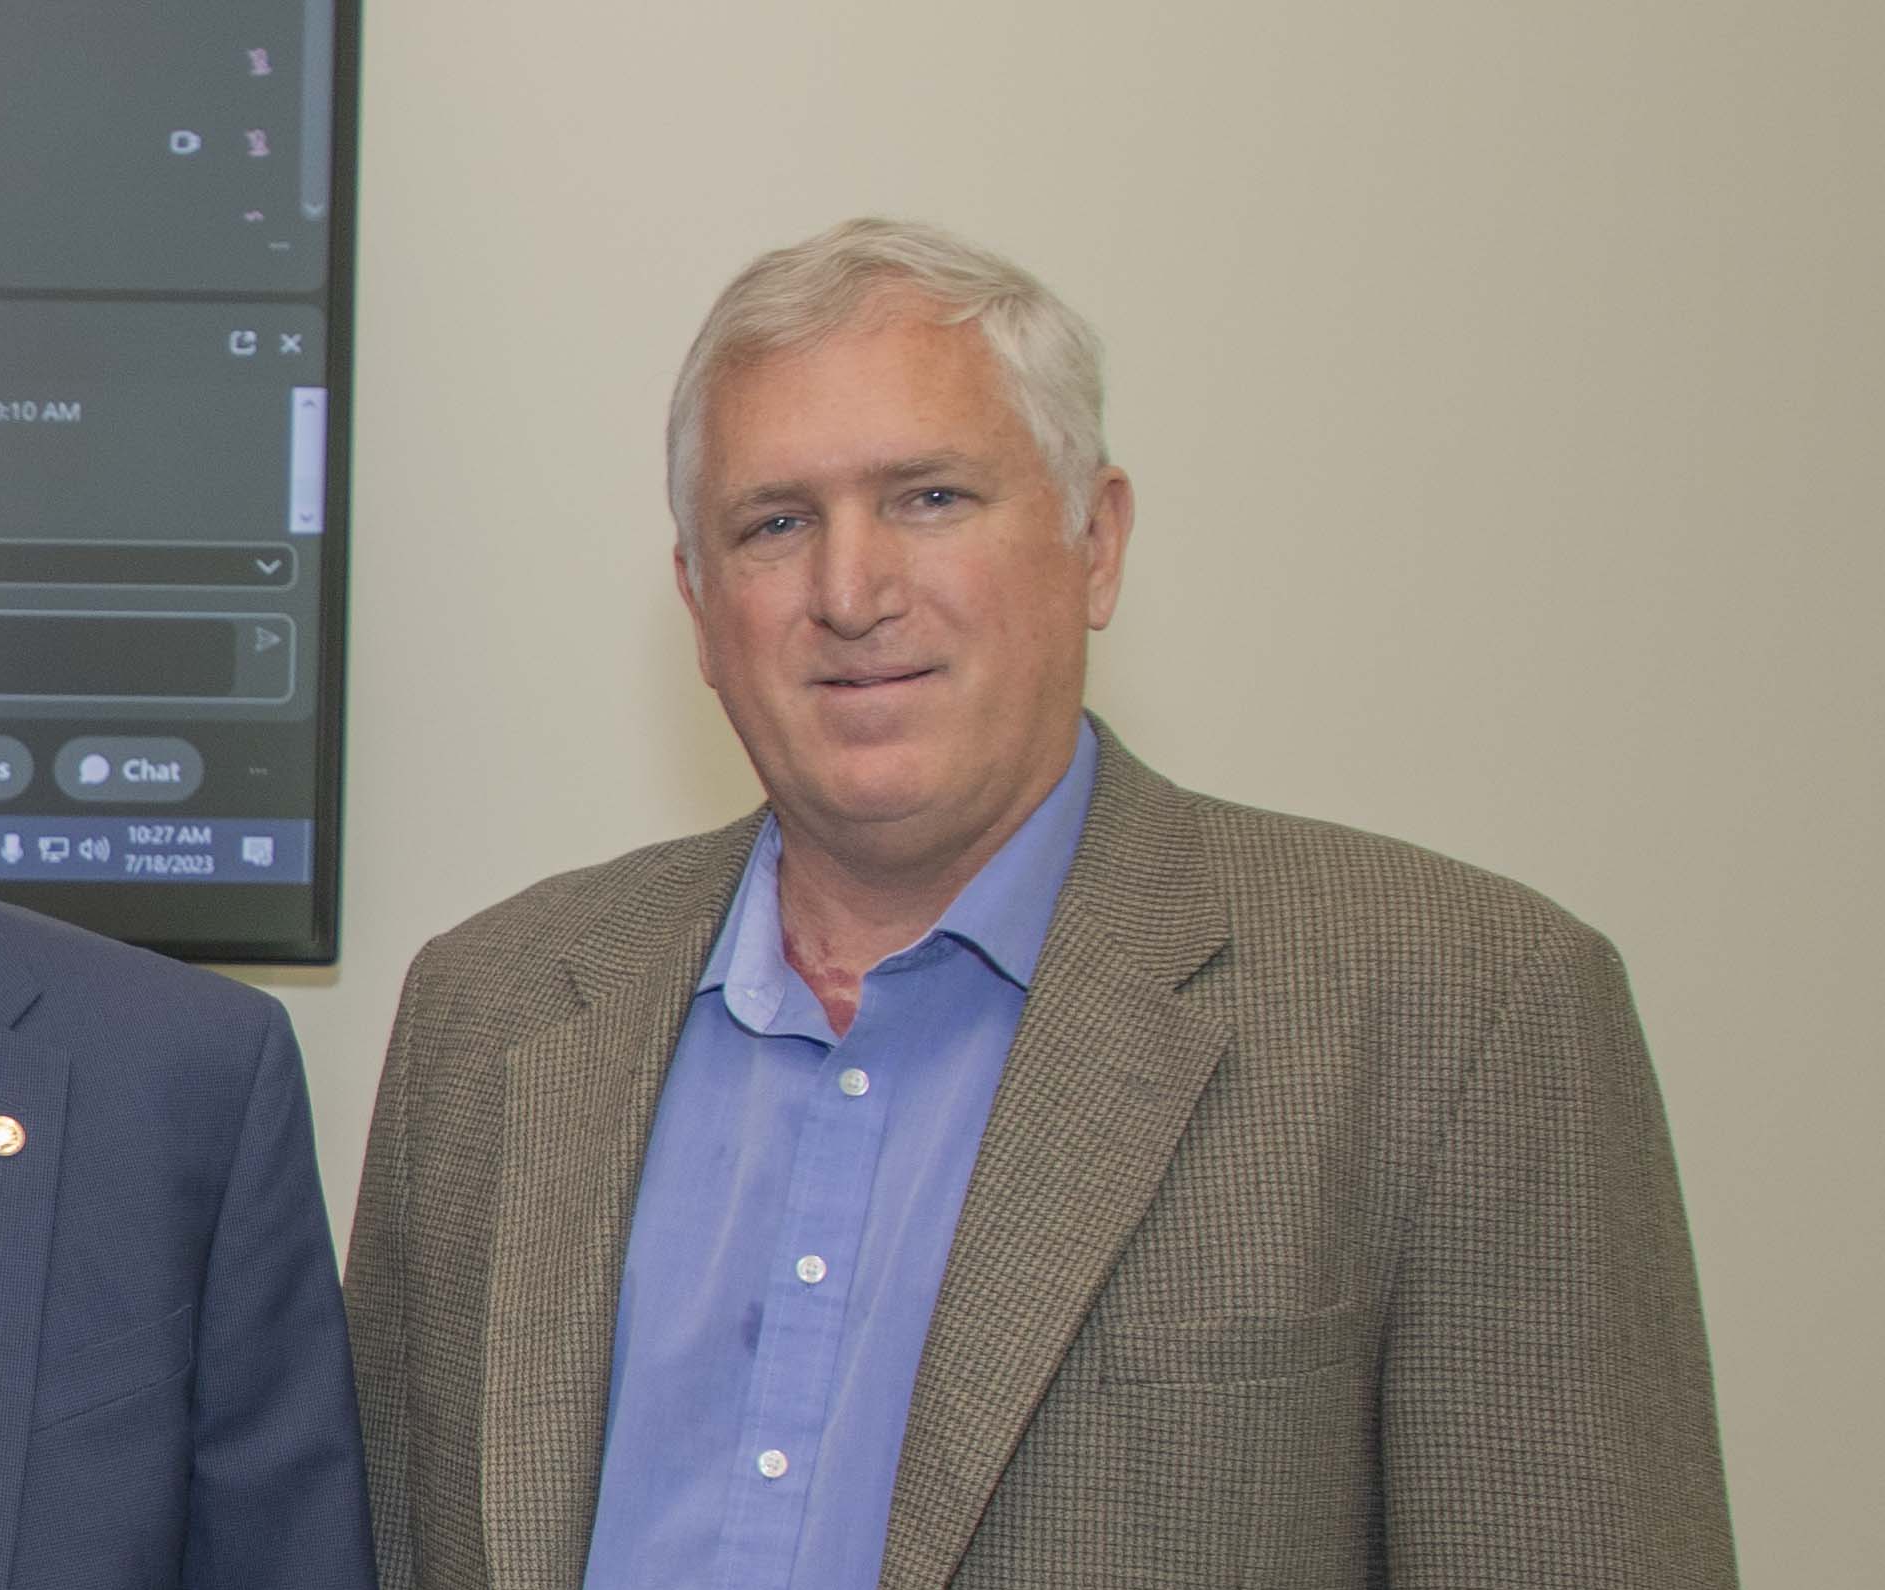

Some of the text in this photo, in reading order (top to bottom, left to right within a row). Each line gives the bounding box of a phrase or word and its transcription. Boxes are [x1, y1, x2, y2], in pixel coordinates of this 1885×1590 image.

[41, 401, 81, 421] AM
[123, 758, 181, 782] Chat
[127, 825, 211, 845] 10:27 AM
[125, 852, 215, 875] 7/18/2023
